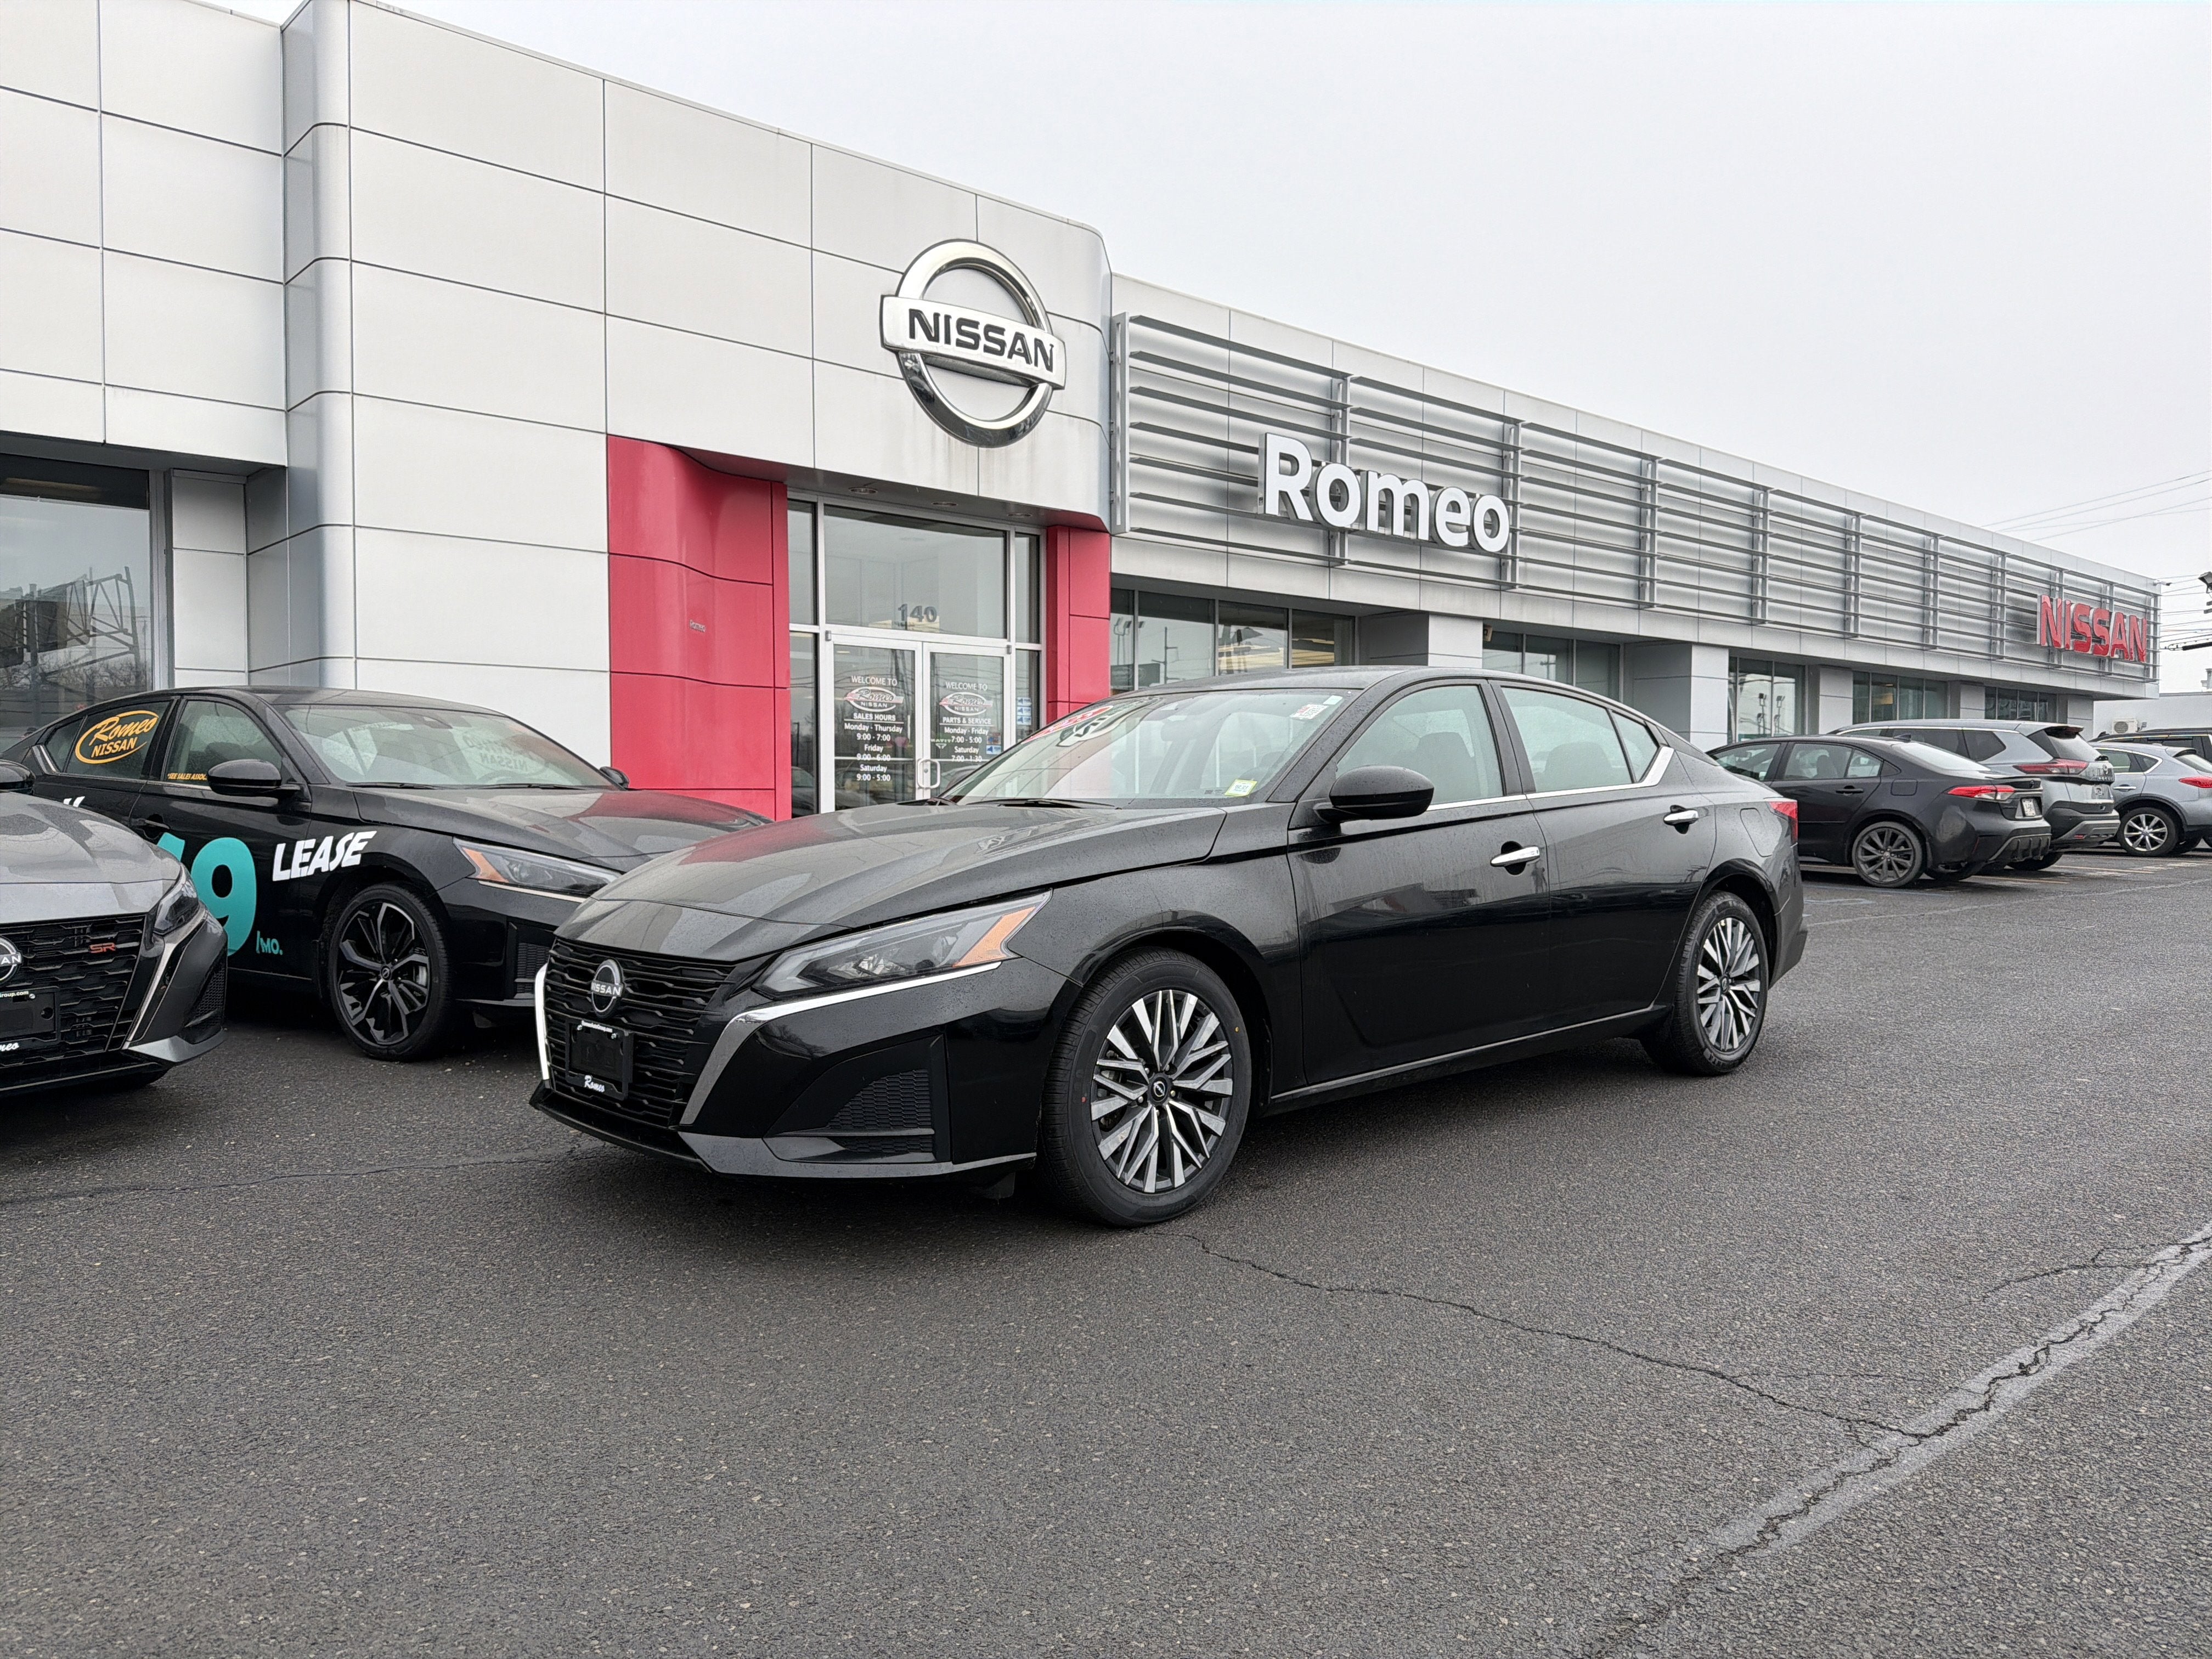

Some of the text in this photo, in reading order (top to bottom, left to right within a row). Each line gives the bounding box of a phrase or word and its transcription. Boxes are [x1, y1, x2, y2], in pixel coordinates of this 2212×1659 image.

[908, 308, 1054, 373] NISSAN
[1260, 432, 1510, 552] Romeo
[898, 603, 938, 623] 140
[2038, 594, 2147, 663] NISSAN
[851, 675, 898, 686] WELCOME TO
[945, 681, 977, 691] WELCOME
[856, 689, 894, 702] Romeo
[88, 716, 159, 746] Romeo
[844, 723, 869, 732] Monday
[874, 724, 903, 734] Thursday
[944, 727, 967, 735] Monday
[971, 727, 989, 736] Friday
[91, 737, 137, 758] NISSAN
[864, 744, 884, 753] Friday
[955, 746, 979, 754] Saturday
[860, 764, 888, 773] Saturday
[272, 831, 377, 882] LEASE
[90, 942, 116, 953] SR
[256, 930, 283, 955] /MO.
